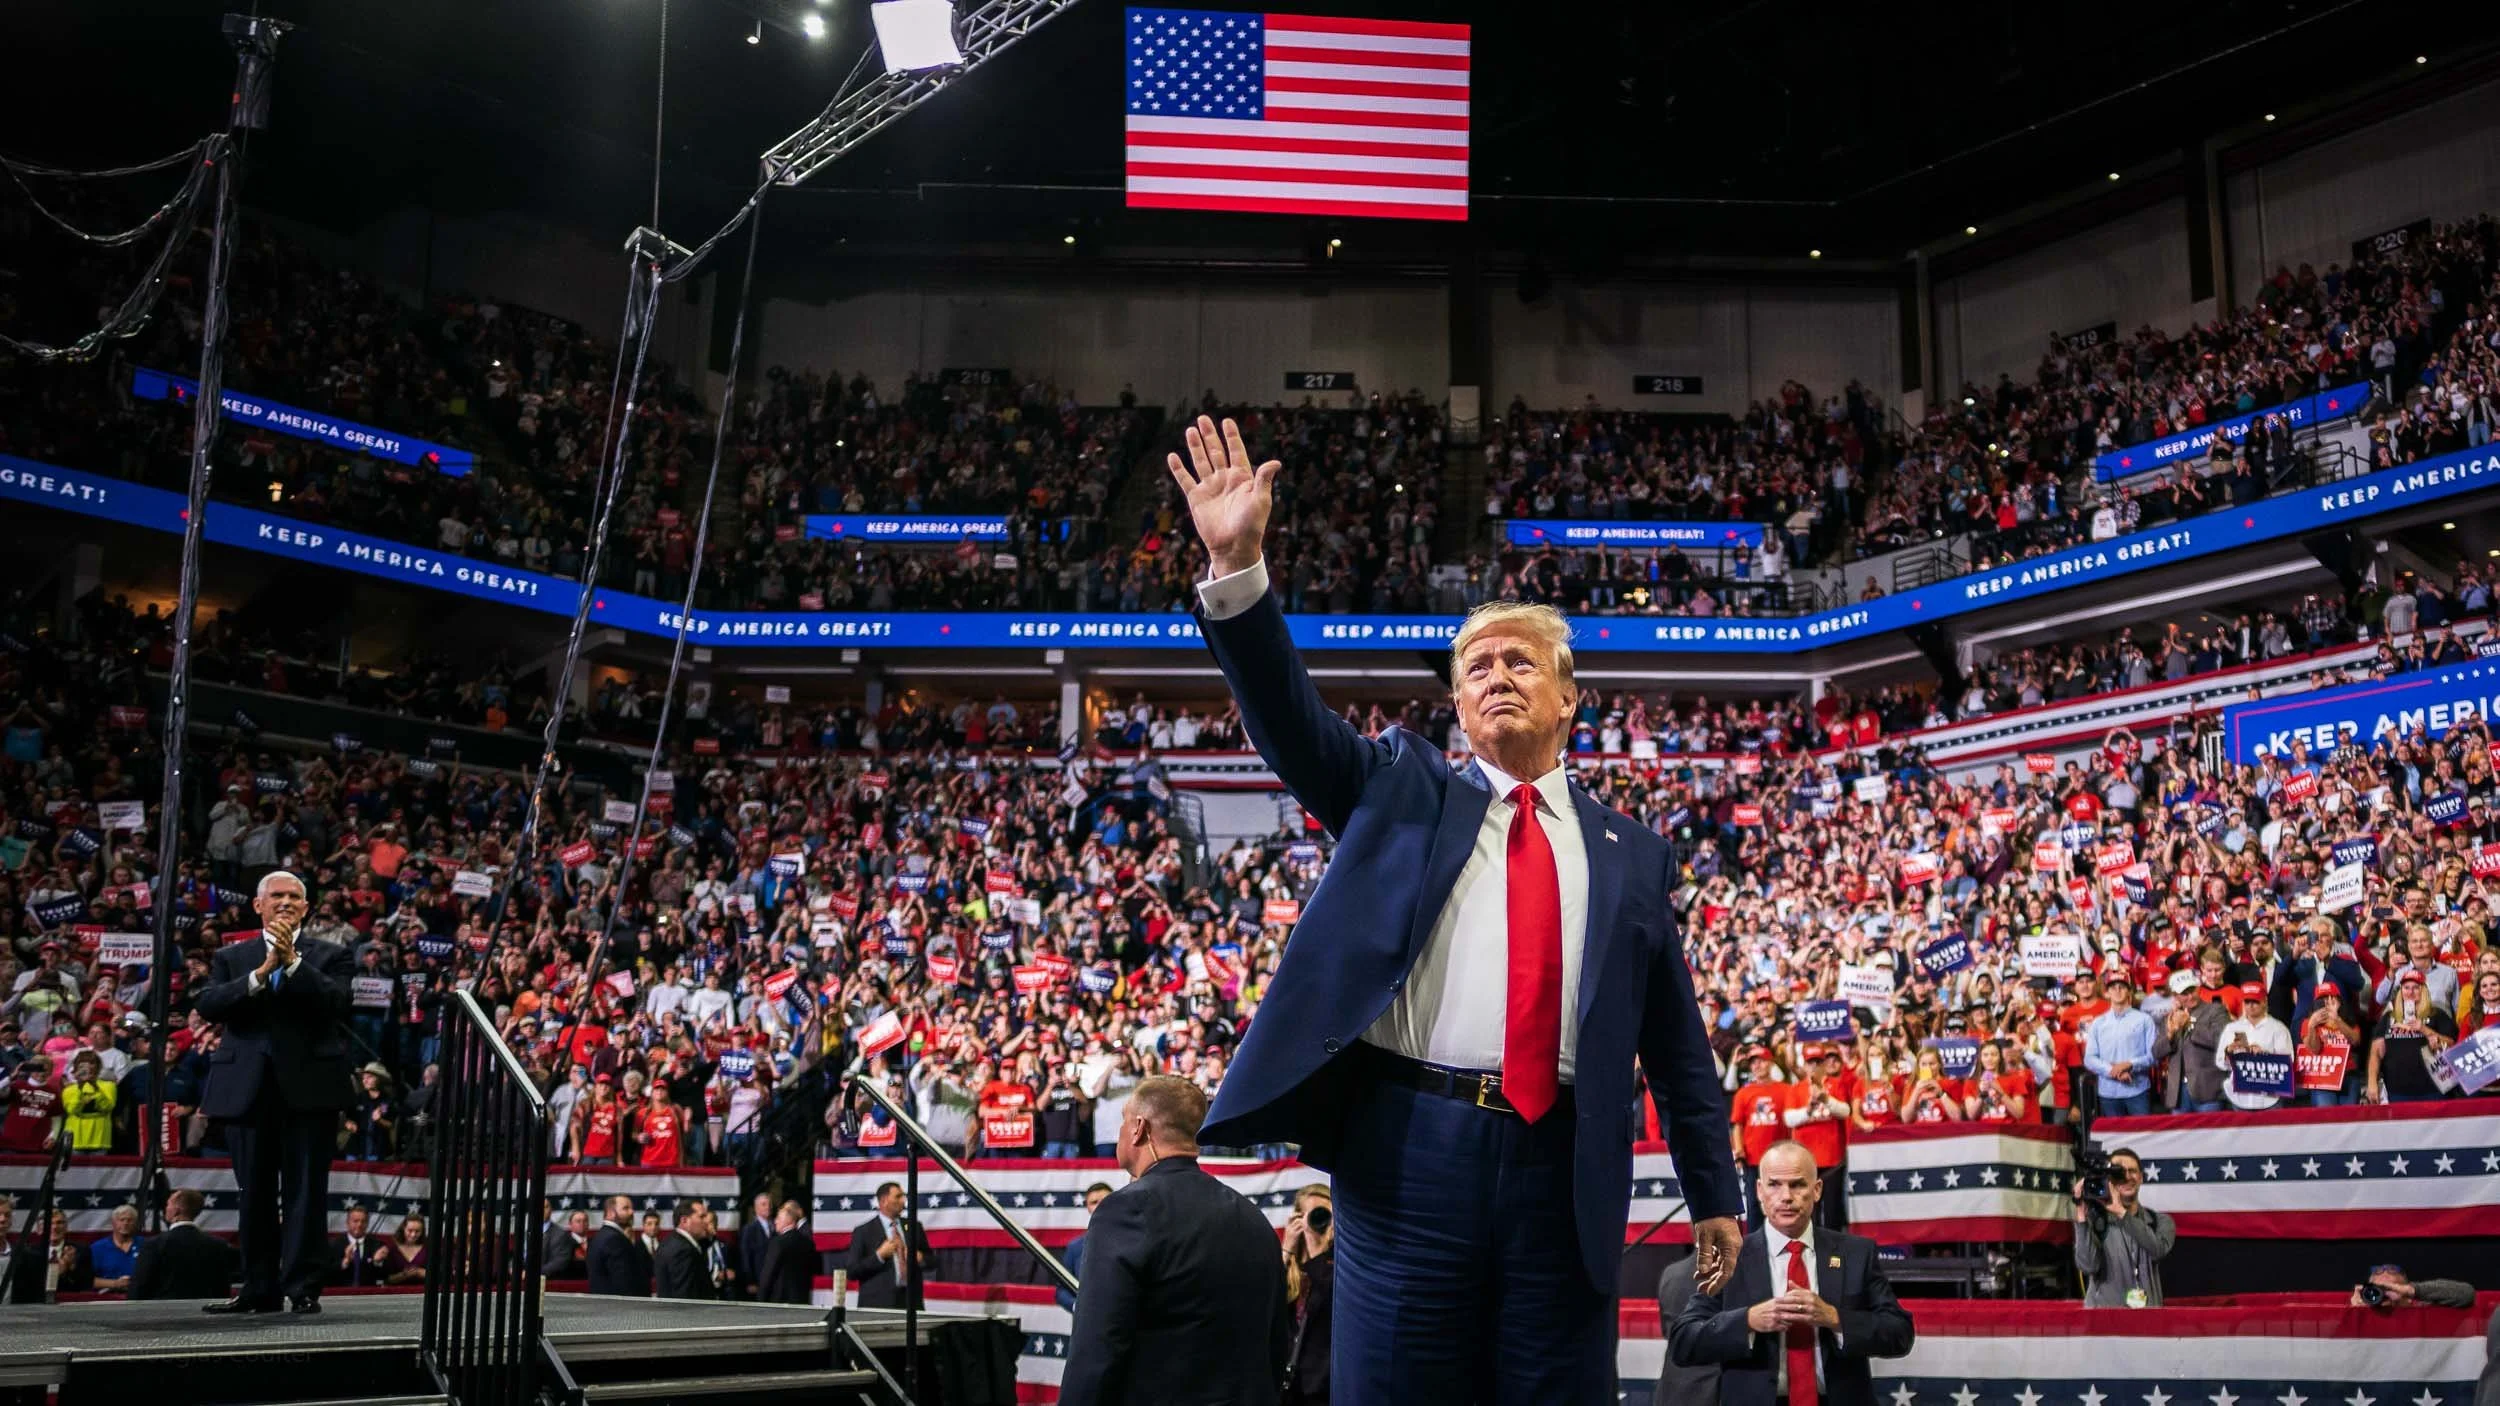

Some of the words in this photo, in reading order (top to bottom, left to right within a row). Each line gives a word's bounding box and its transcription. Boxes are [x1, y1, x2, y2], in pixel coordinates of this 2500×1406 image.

[1304, 374, 1334, 388] 217
[1653, 378, 1684, 392] 218
[221, 397, 262, 416] KEEP
[267, 411, 339, 437] AMERICA
[344, 430, 400, 453] GREAT!
[2155, 440, 2188, 458] KEEP
[0, 469, 106, 503] GREAT!
[2322, 485, 2380, 511] KEEP
[2391, 455, 2500, 494] AMERICA
[866, 522, 900, 533] KEEP
[902, 522, 959, 534] AMERICA
[1567, 527, 1600, 538] KEEP
[1601, 528, 1658, 538] AMERICA
[1659, 528, 1705, 539] GREAT!
[259, 523, 322, 547] KEEP
[336, 542, 444, 575] AMERICA
[456, 568, 538, 596] GREAT!
[1966, 574, 2013, 598] KEEP
[2020, 554, 2108, 585] AMERICA
[2116, 532, 2191, 560] GREAT!
[658, 611, 709, 633] KEEP
[718, 622, 809, 636] AMERICA
[818, 622, 891, 636] GREAT!
[1009, 623, 1061, 636] KEEP
[1083, 623, 1160, 637] AMERICA
[1656, 627, 1706, 640] KEEP
[1714, 627, 1801, 640] AMERICA
[1808, 611, 1868, 636] GREAT!
[1323, 625, 1372, 638] KEEP
[2270, 720, 2358, 757] KEEP
[2428, 797, 2462, 815] TRUMP
[2336, 843, 2375, 860] TRUMP
[2322, 878, 2360, 896] AMERICA
[104, 949, 153, 959] TRUMP
[1924, 941, 1966, 967] TRUMP
[2027, 951, 2075, 959] AMERICA
[1843, 982, 1890, 993] AMERICA
[1799, 1009, 1848, 1022] TRUMP
[2236, 1061, 2289, 1074] TRUMP
[2298, 1055, 2342, 1066] TRUMP
[989, 1121, 1030, 1132] TRUMP
